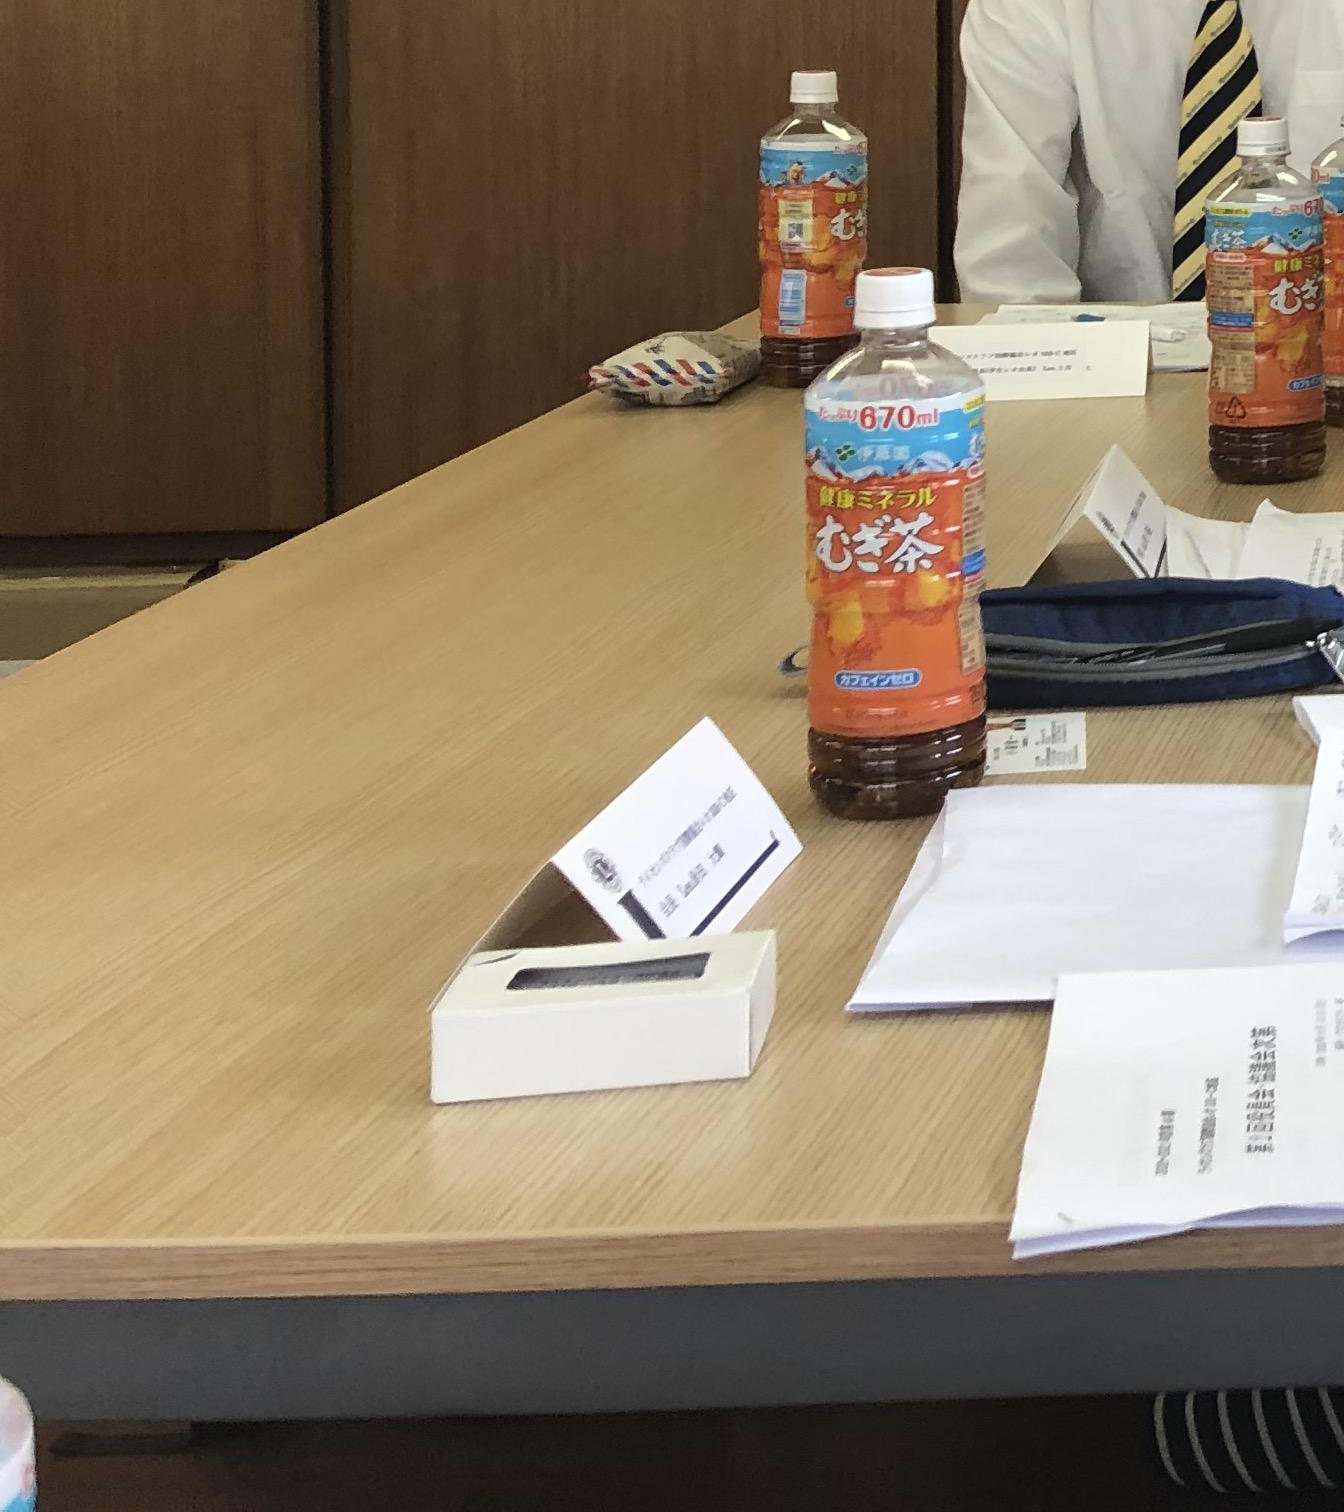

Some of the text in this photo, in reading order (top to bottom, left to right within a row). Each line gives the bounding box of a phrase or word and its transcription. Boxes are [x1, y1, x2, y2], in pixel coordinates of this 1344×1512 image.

[818, 486, 937, 510] 健康ミネラル
[815, 511, 944, 574] むぎ茶
[838, 672, 915, 687] カフェインゼロ
